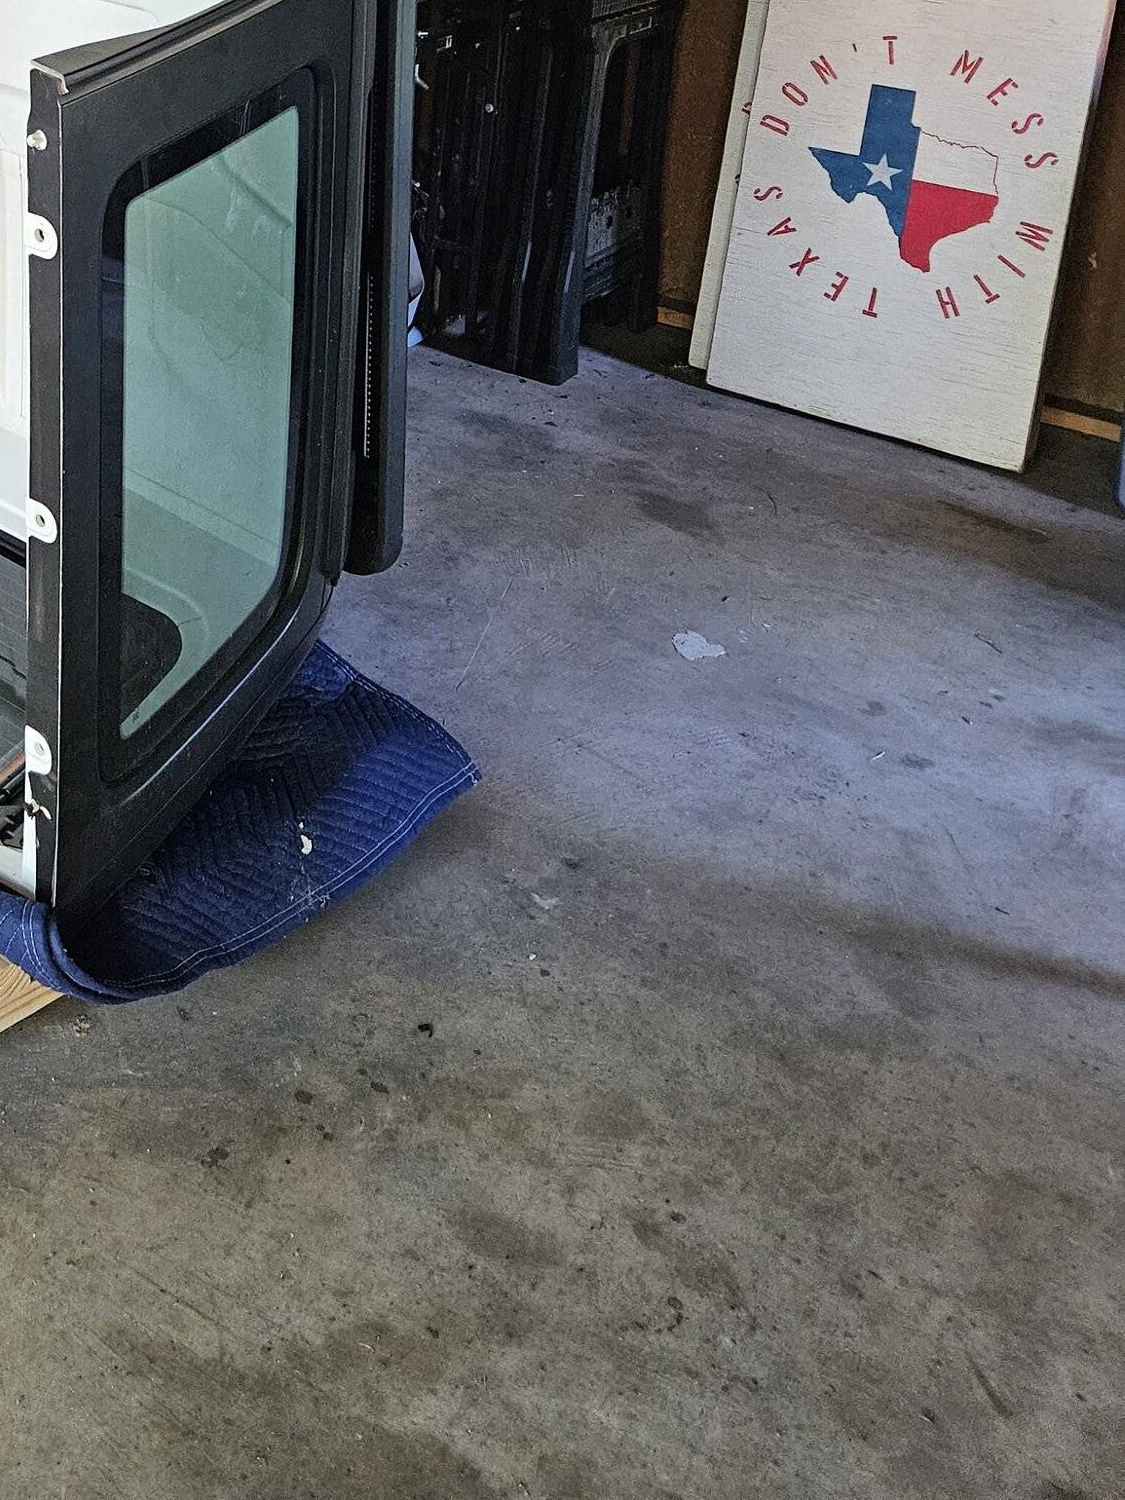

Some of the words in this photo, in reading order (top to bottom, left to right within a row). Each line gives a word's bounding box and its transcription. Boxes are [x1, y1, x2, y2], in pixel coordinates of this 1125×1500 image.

[759, 35, 898, 137] DON'T
[949, 49, 1059, 169] MESS
[753, 185, 879, 318] TEXAS
[935, 221, 1054, 319] WITH
